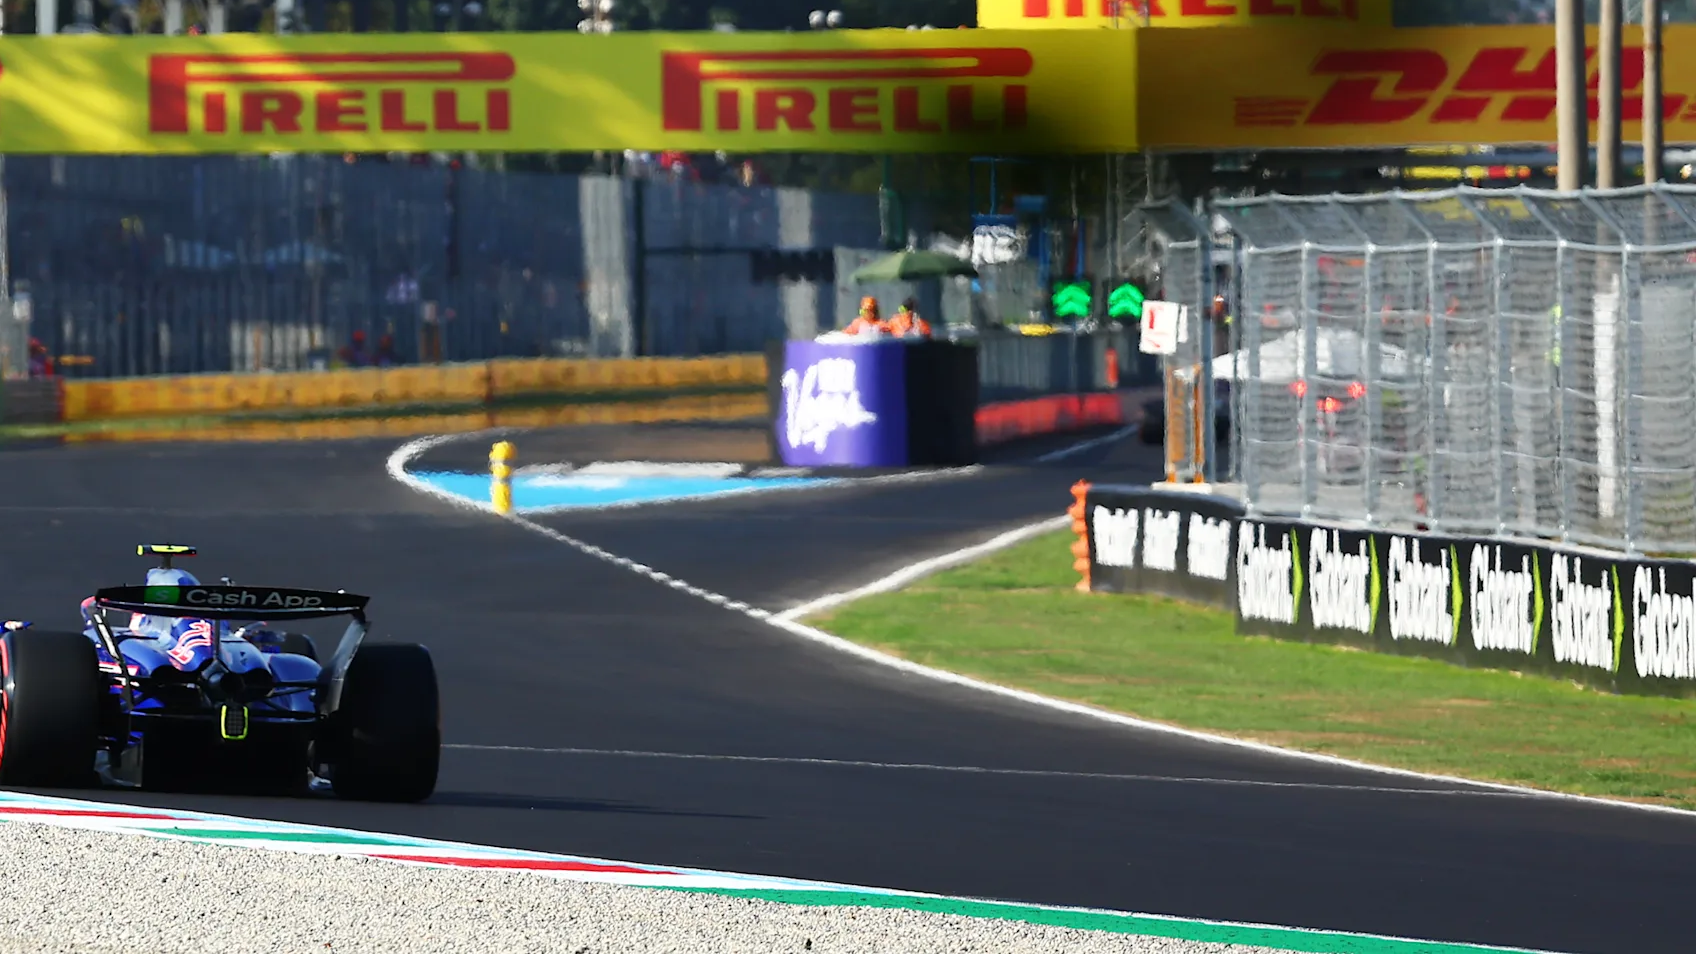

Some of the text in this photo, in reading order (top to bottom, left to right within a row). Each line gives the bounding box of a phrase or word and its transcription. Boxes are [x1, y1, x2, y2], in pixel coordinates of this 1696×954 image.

[148, 53, 516, 133] PIRELLI
[661, 48, 1033, 132] PIRELLI
[1305, 47, 1687, 124] DHL
[186, 589, 257, 606] Cash
[262, 592, 322, 607] App
